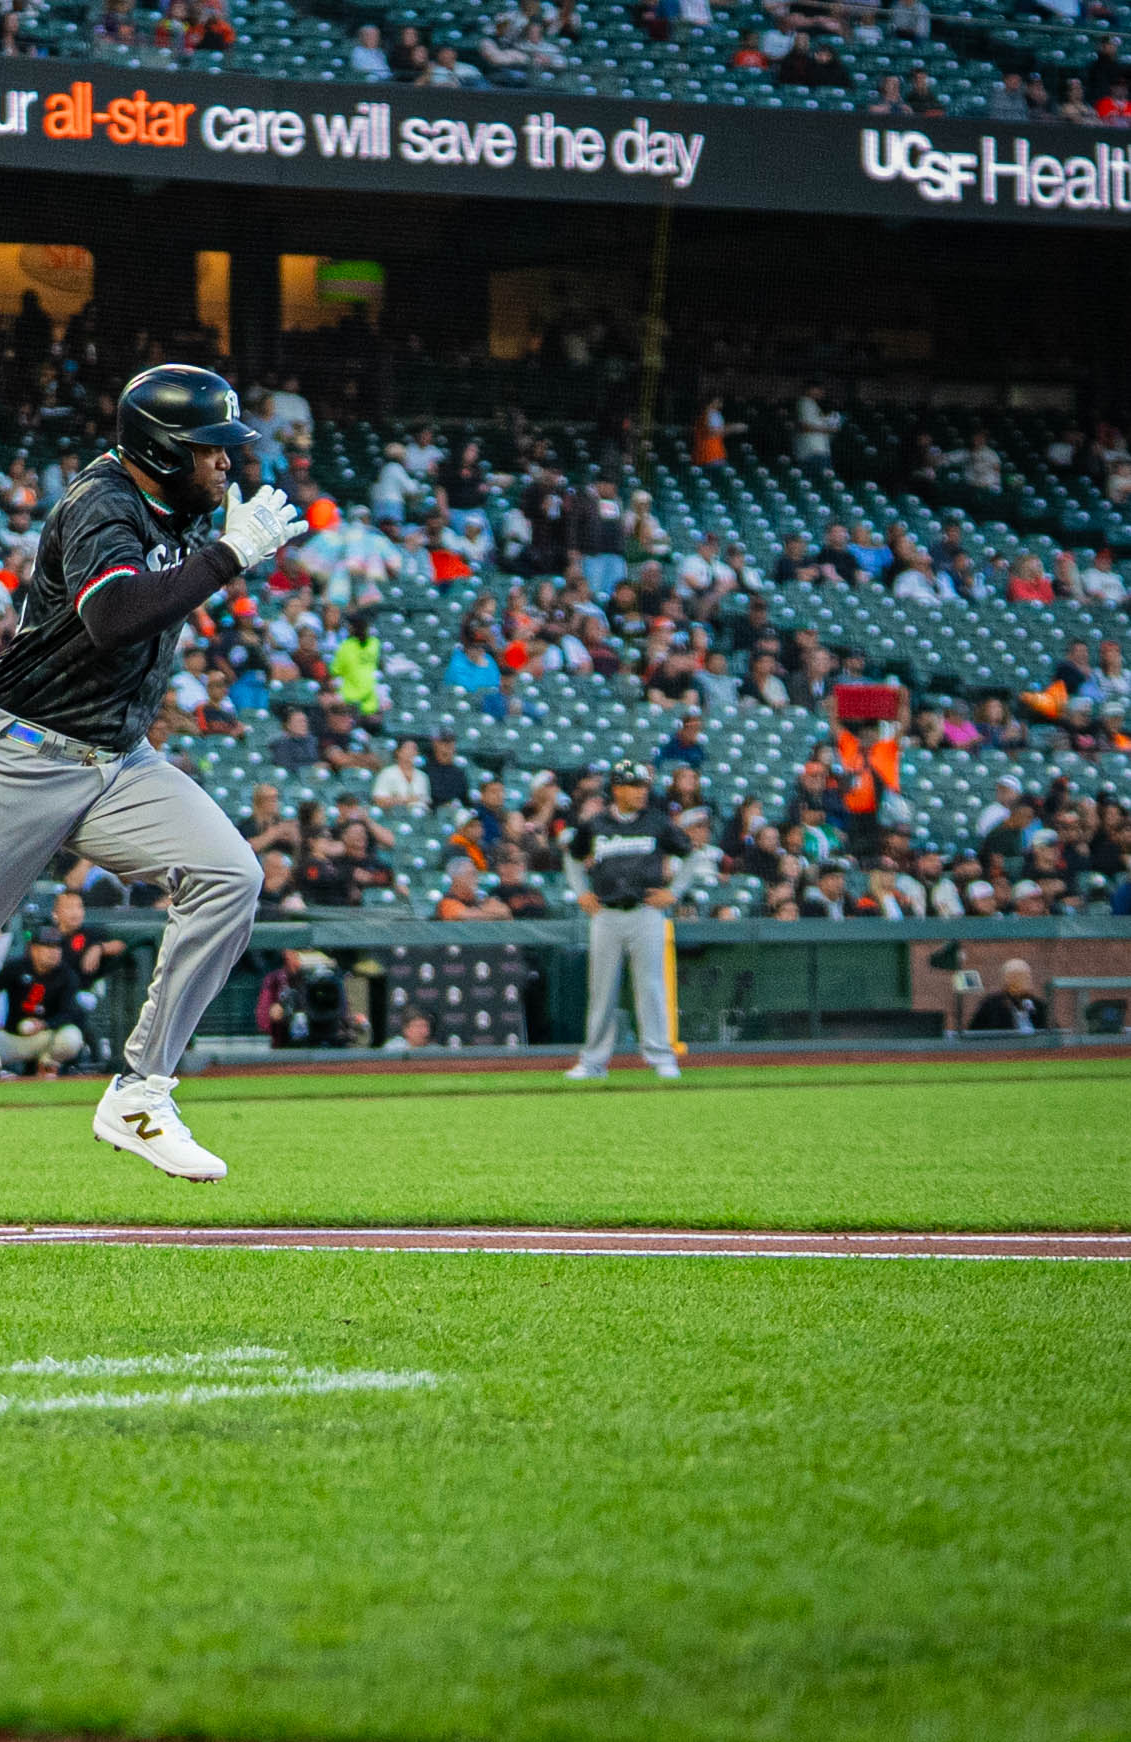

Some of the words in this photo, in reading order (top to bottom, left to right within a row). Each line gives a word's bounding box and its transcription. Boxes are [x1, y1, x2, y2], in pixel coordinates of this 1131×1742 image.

[43, 81, 197, 148] all-star
[201, 103, 306, 156] care
[312, 102, 391, 160] will
[399, 115, 517, 168] save
[524, 112, 606, 172] the
[611, 117, 705, 188] day
[862, 128, 978, 202] UCSF
[981, 136, 1131, 212] Healt
[122, 1111, 164, 1142] N
